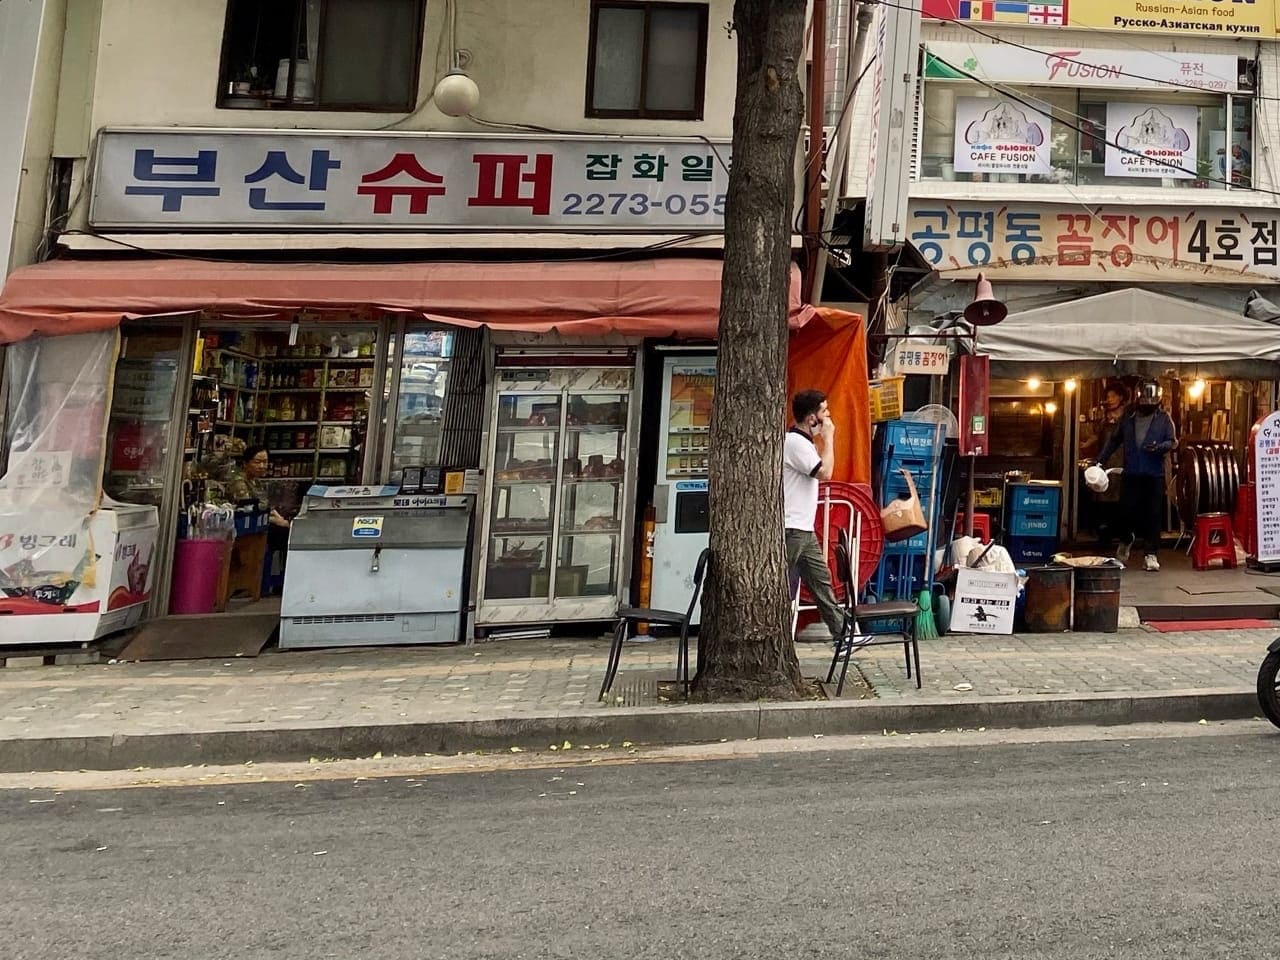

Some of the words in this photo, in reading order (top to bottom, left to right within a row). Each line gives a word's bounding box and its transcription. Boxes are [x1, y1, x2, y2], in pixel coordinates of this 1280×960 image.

[1135, 2, 1208, 16] Russian-Asian
[1212, 6, 1235, 17] food
[1113, 16, 1223, 32] Русско-Азиатская
[1226, 24, 1260, 34] кухня
[1180, 62, 1205, 76] 퓨전
[970, 153, 996, 161] CAFE
[1000, 153, 1036, 162] FUSION
[1120, 157, 1145, 166] CAFE
[1149, 157, 1183, 167] FUSION
[586, 153, 716, 182] 잡화일
[562, 193, 725, 216] 2273-055
[911, 209, 1043, 267] 공평동
[1056, 213, 1180, 268] 꼼장어
[1187, 218, 1278, 267] 4호점
[19, 533, 77, 548] 빙그레
